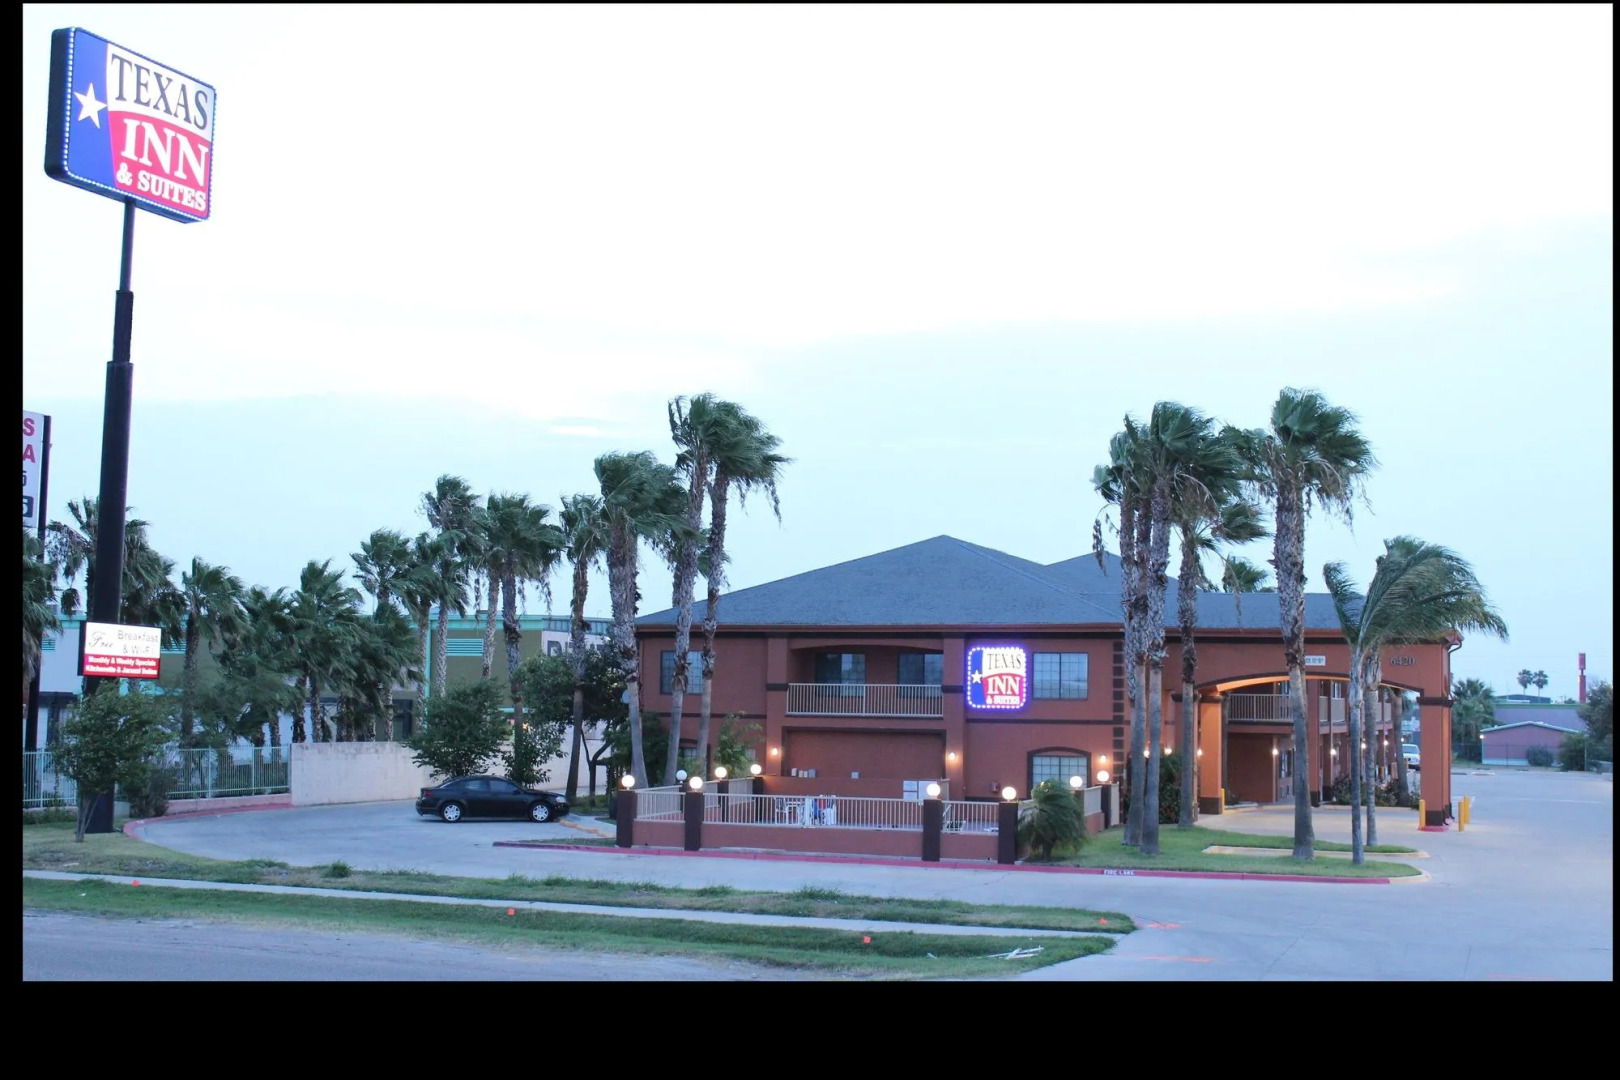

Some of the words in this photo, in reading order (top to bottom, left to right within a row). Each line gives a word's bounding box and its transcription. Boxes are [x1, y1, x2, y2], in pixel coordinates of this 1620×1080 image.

[111, 53, 208, 130] TEXAS
[121, 118, 209, 187] INN
[117, 162, 133, 186] &
[137, 170, 206, 212] SUITES
[88, 630, 114, 648] Free
[117, 629, 158, 643] Breakfast
[123, 644, 128, 654] &
[88, 656, 110, 665] Monthly
[116, 657, 135, 667] Weekly
[135, 658, 156, 667] Specials
[987, 653, 1022, 670] TEXAS
[1391, 655, 1416, 667] 6420
[141, 667, 158, 675] Suites
[987, 675, 1021, 695] INN
[986, 695, 993, 705] &
[993, 695, 1020, 705] SUITES
